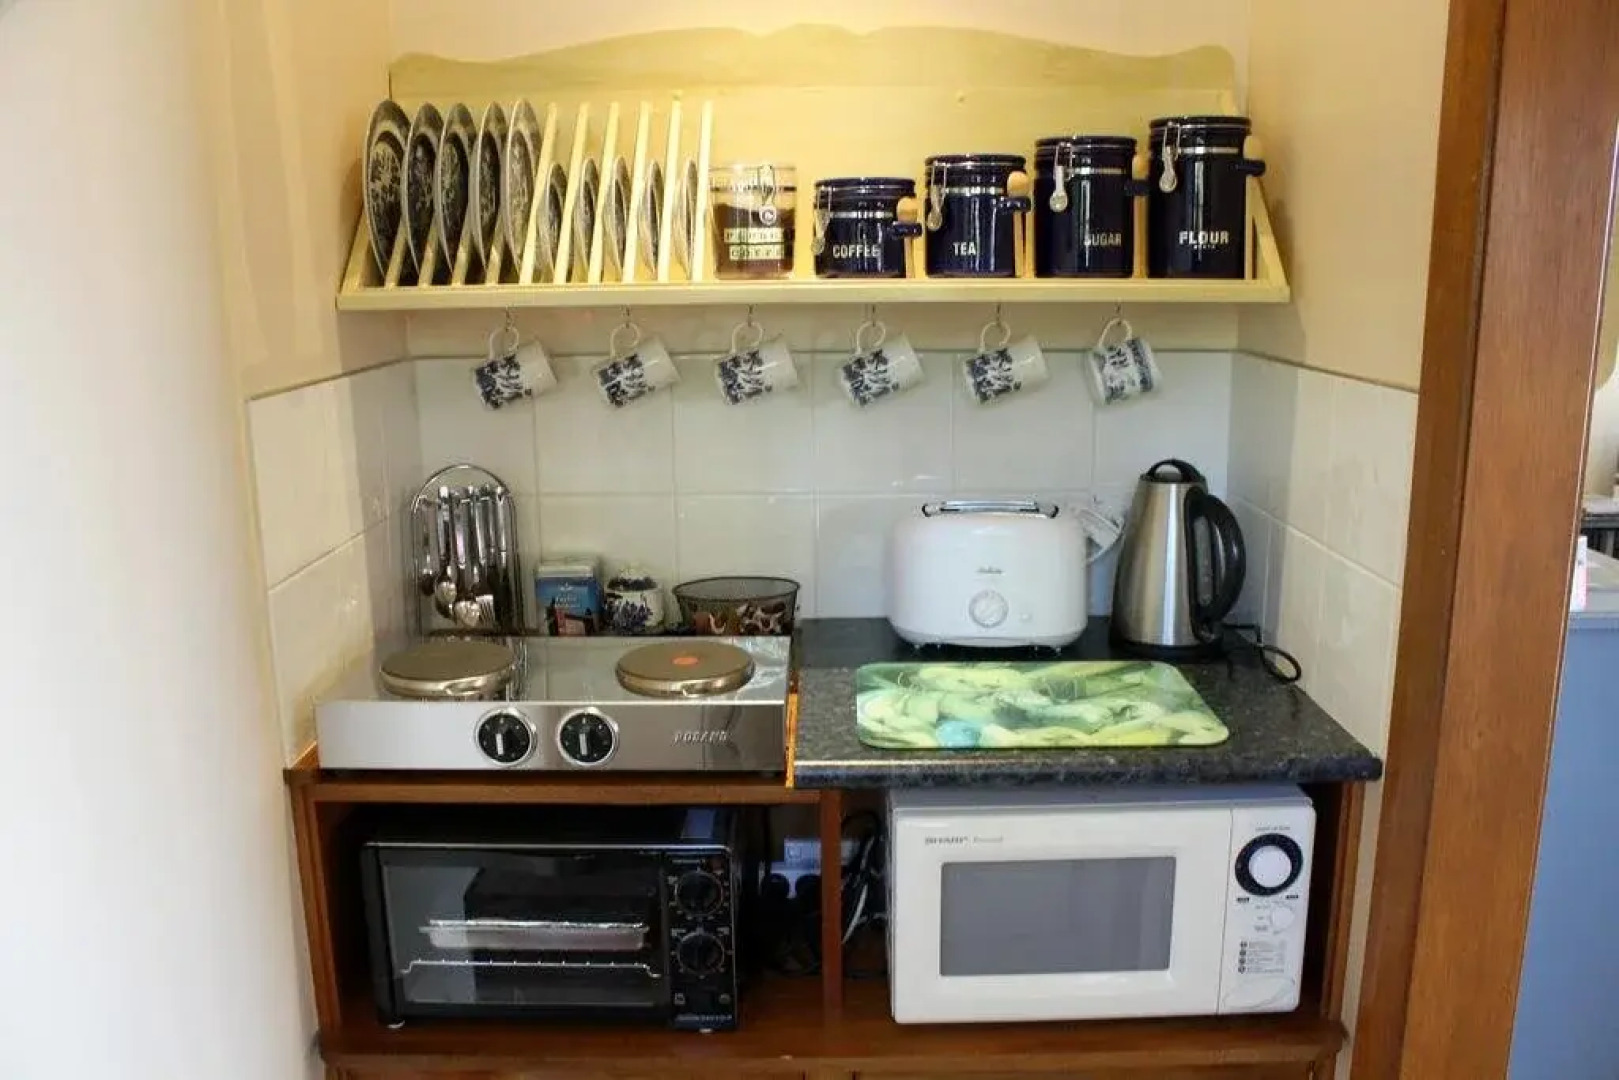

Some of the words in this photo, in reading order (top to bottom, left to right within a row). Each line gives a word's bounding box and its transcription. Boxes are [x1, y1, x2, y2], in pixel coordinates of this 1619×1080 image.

[1083, 232, 1122, 246] SUGAR
[1178, 230, 1230, 245] FLOUR
[832, 243, 881, 259] COFFEE
[952, 242, 977, 257] TEA
